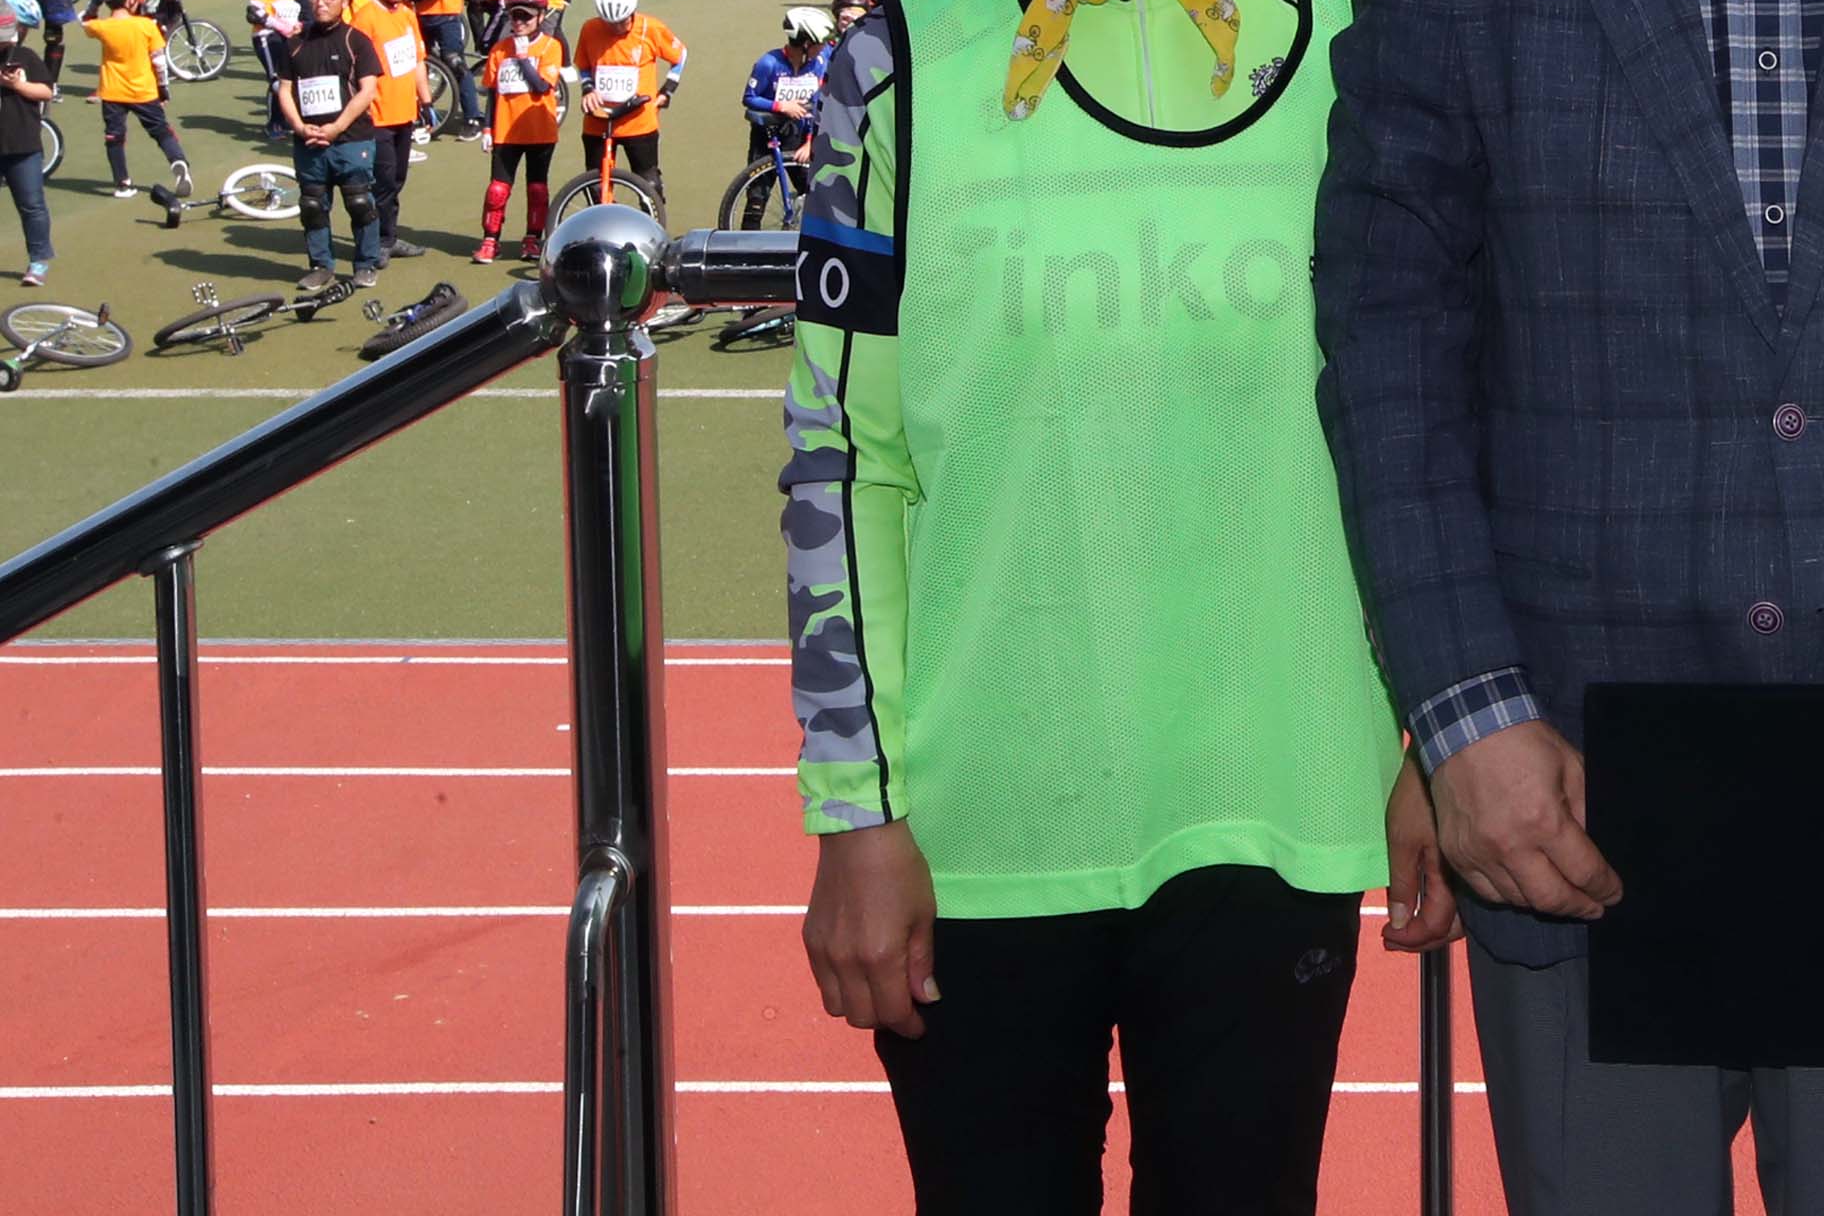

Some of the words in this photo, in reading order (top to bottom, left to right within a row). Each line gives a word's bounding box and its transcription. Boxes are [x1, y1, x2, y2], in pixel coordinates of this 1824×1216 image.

[599, 77, 633, 92] 50118
[302, 88, 336, 105] 60114
[778, 88, 814, 101] 50103
